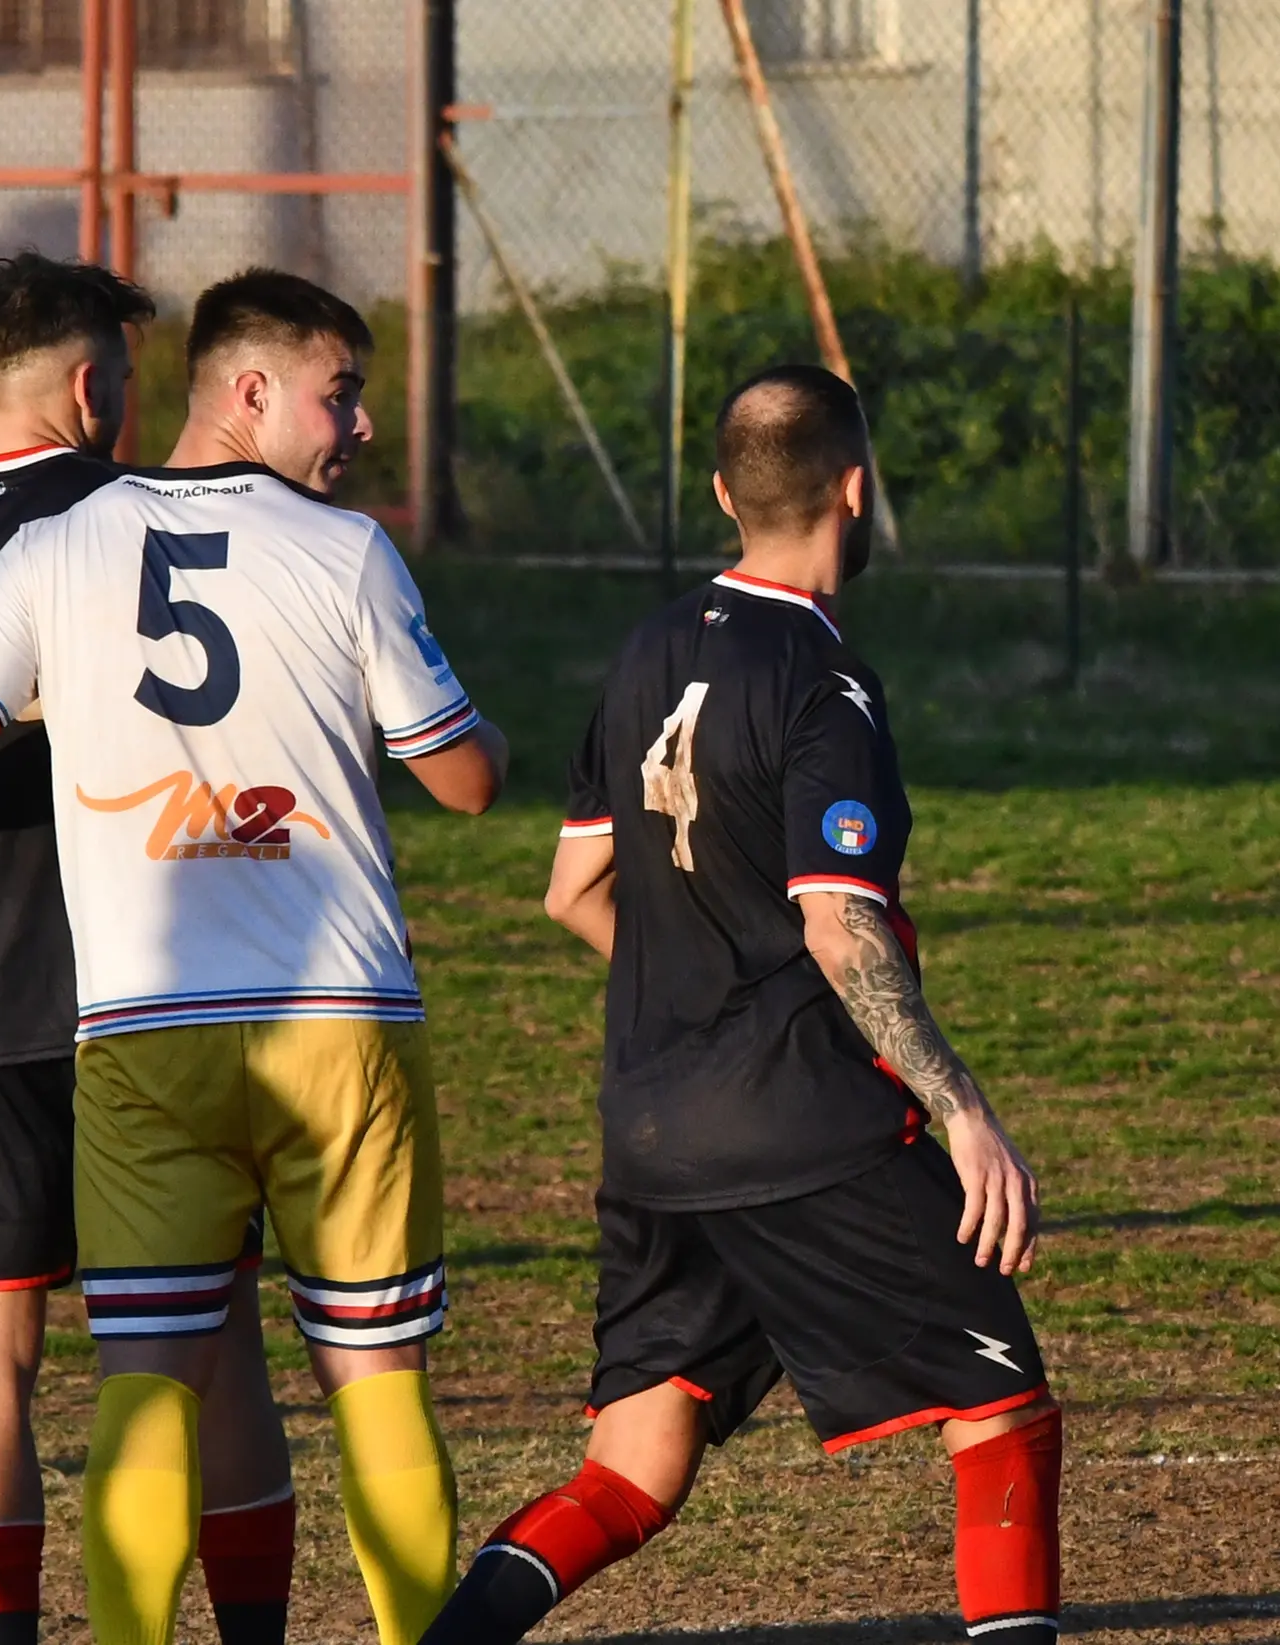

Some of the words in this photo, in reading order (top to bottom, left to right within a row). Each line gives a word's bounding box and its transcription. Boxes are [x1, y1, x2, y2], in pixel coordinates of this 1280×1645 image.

[123, 479, 254, 499] NOVANTACINQUE
[134, 525, 240, 727] 5
[77, 770, 297, 860] M2
[641, 682, 710, 872] 4
[176, 846, 282, 860] REGALI
